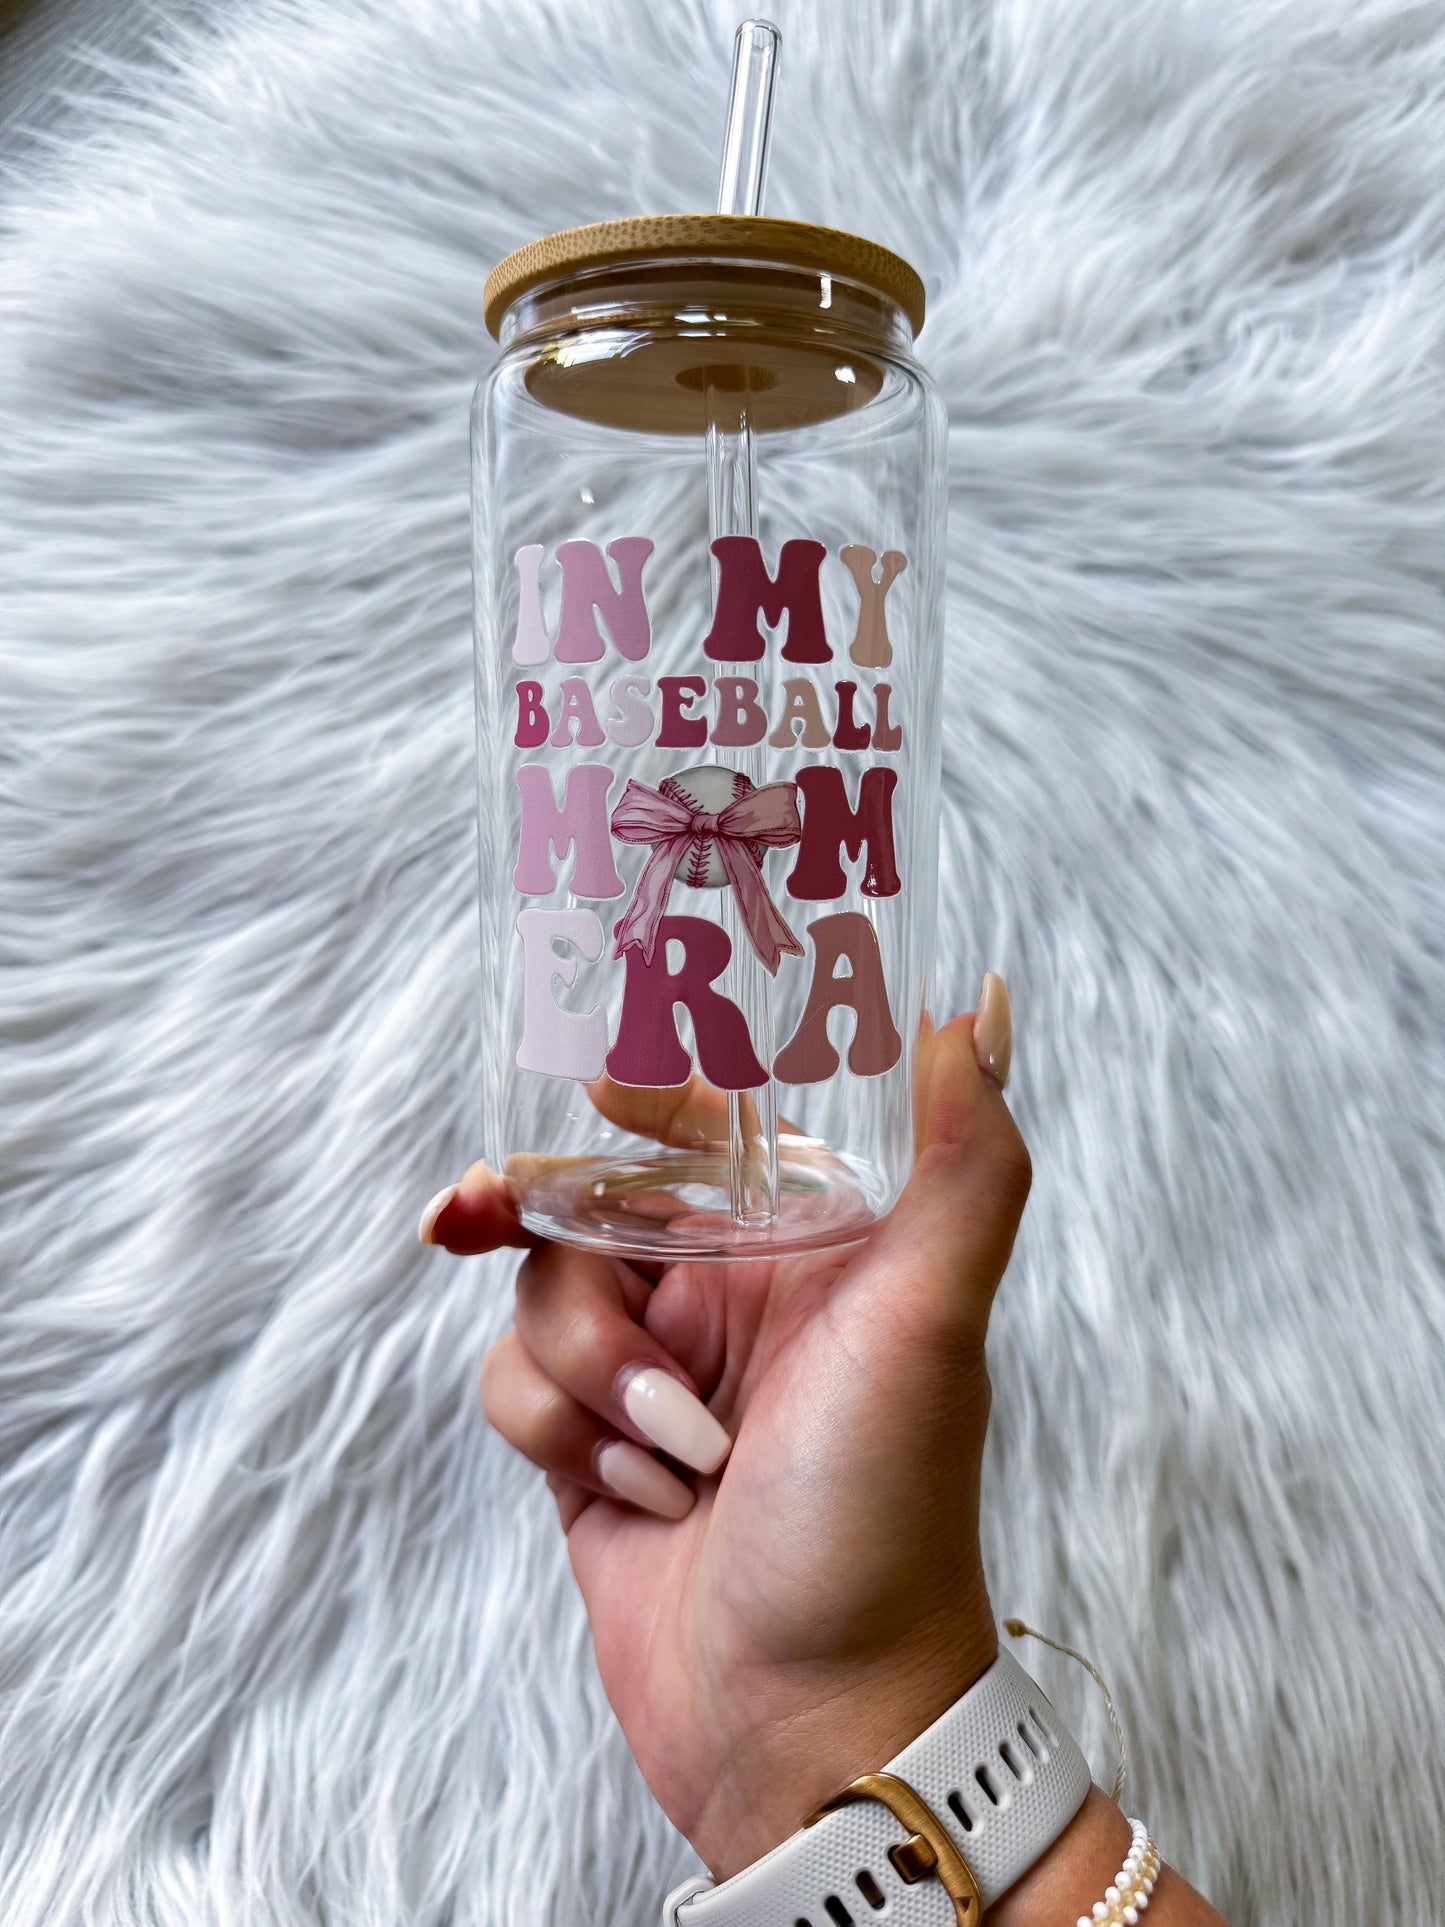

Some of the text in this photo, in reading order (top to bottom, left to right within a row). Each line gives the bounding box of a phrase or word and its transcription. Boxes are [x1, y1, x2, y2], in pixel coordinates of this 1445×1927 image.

[513, 535, 908, 668] IN MY
[514, 675, 903, 752] BASEBALL
[515, 908, 903, 1090] ERA
